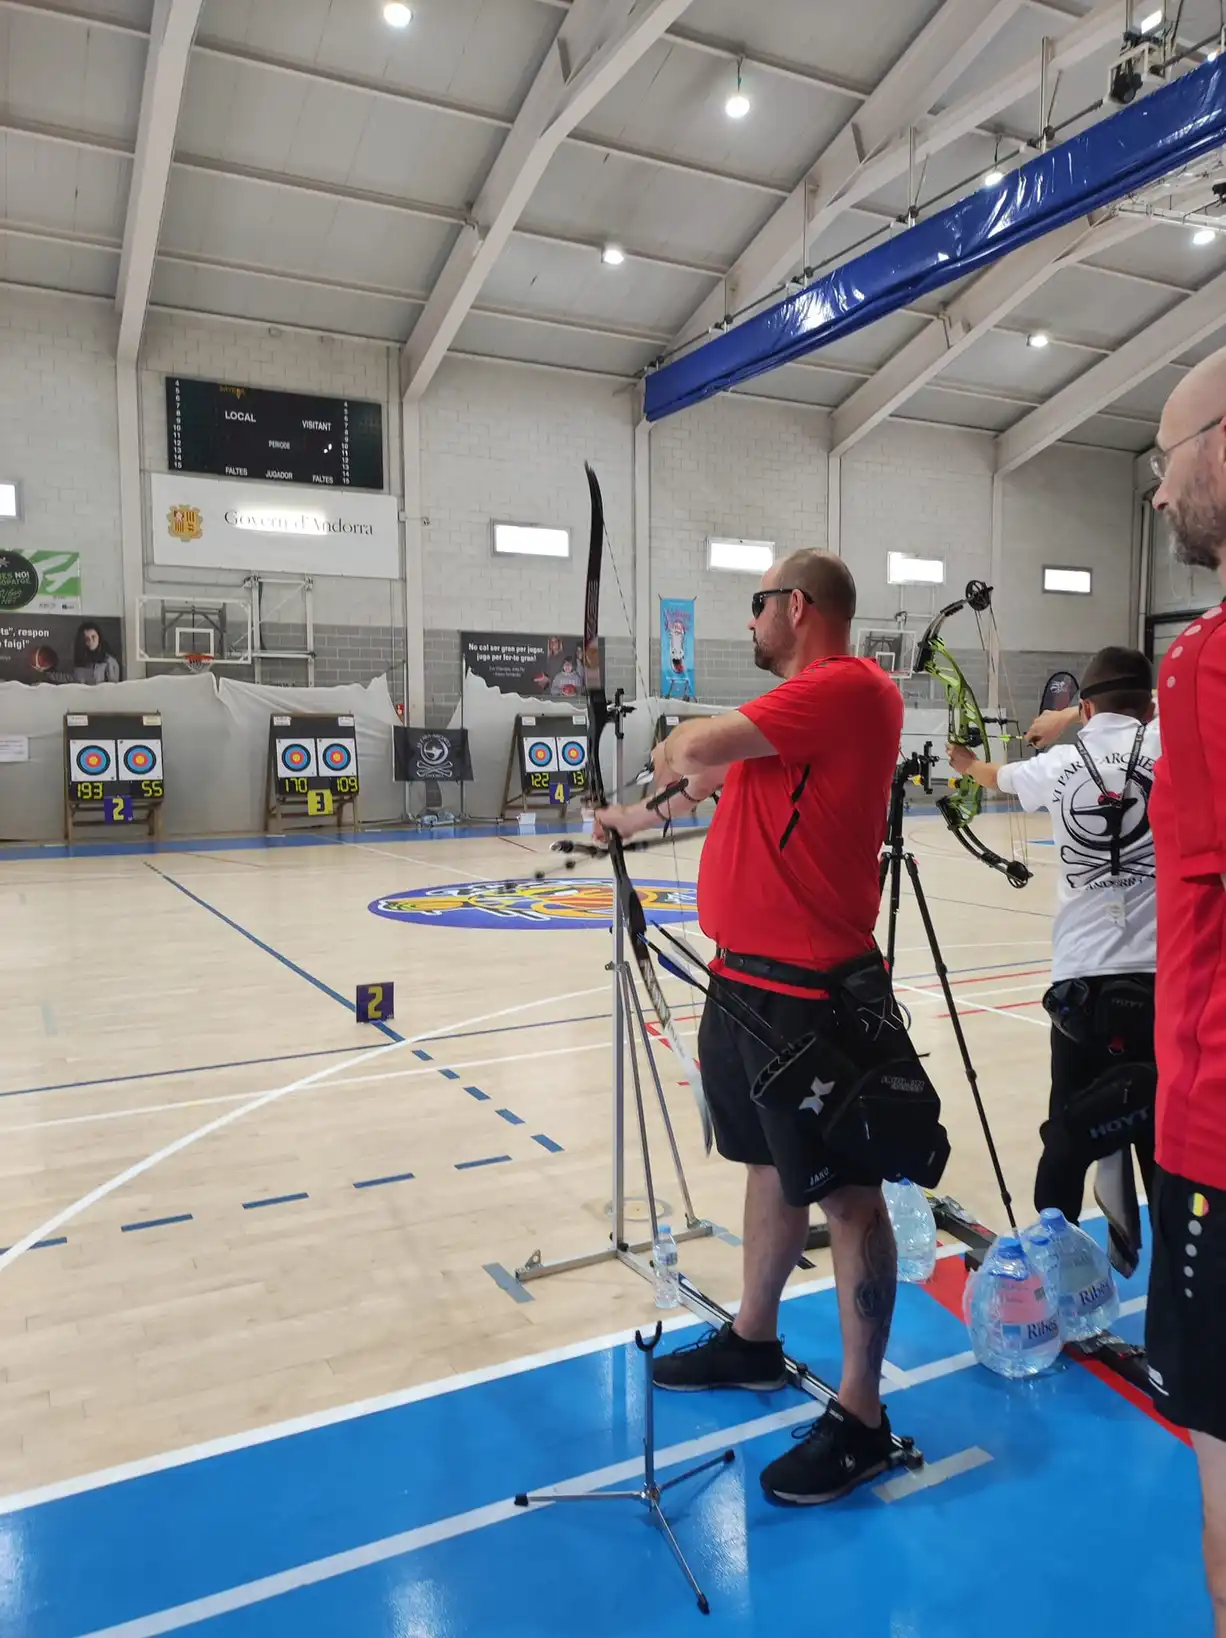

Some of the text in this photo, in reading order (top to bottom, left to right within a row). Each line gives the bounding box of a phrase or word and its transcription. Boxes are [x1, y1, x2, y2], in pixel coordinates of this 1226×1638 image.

[224, 410, 256, 422] LOCAL
[302, 420, 332, 432] VISITANT
[225, 466, 248, 476] FALTES
[266, 470, 293, 480] JUGADOR
[312, 474, 334, 484] FALTES
[18, 628, 50, 639] respon
[468, 642, 478, 651] No
[501, 646, 515, 654] gran
[476, 652, 490, 662] juga
[492, 654, 502, 662] per
[520, 654, 537, 663] gran!
[284, 776, 358, 793] 170 109
[530, 772, 550, 788] 122
[77, 780, 163, 800] 193 55
[554, 782, 564, 804] 4
[112, 798, 124, 820] 2
[316, 792, 325, 812] 3
[367, 986, 383, 1020] 2
[1089, 1106, 1150, 1139] HOYT
[809, 1166, 830, 1187] JAKO
